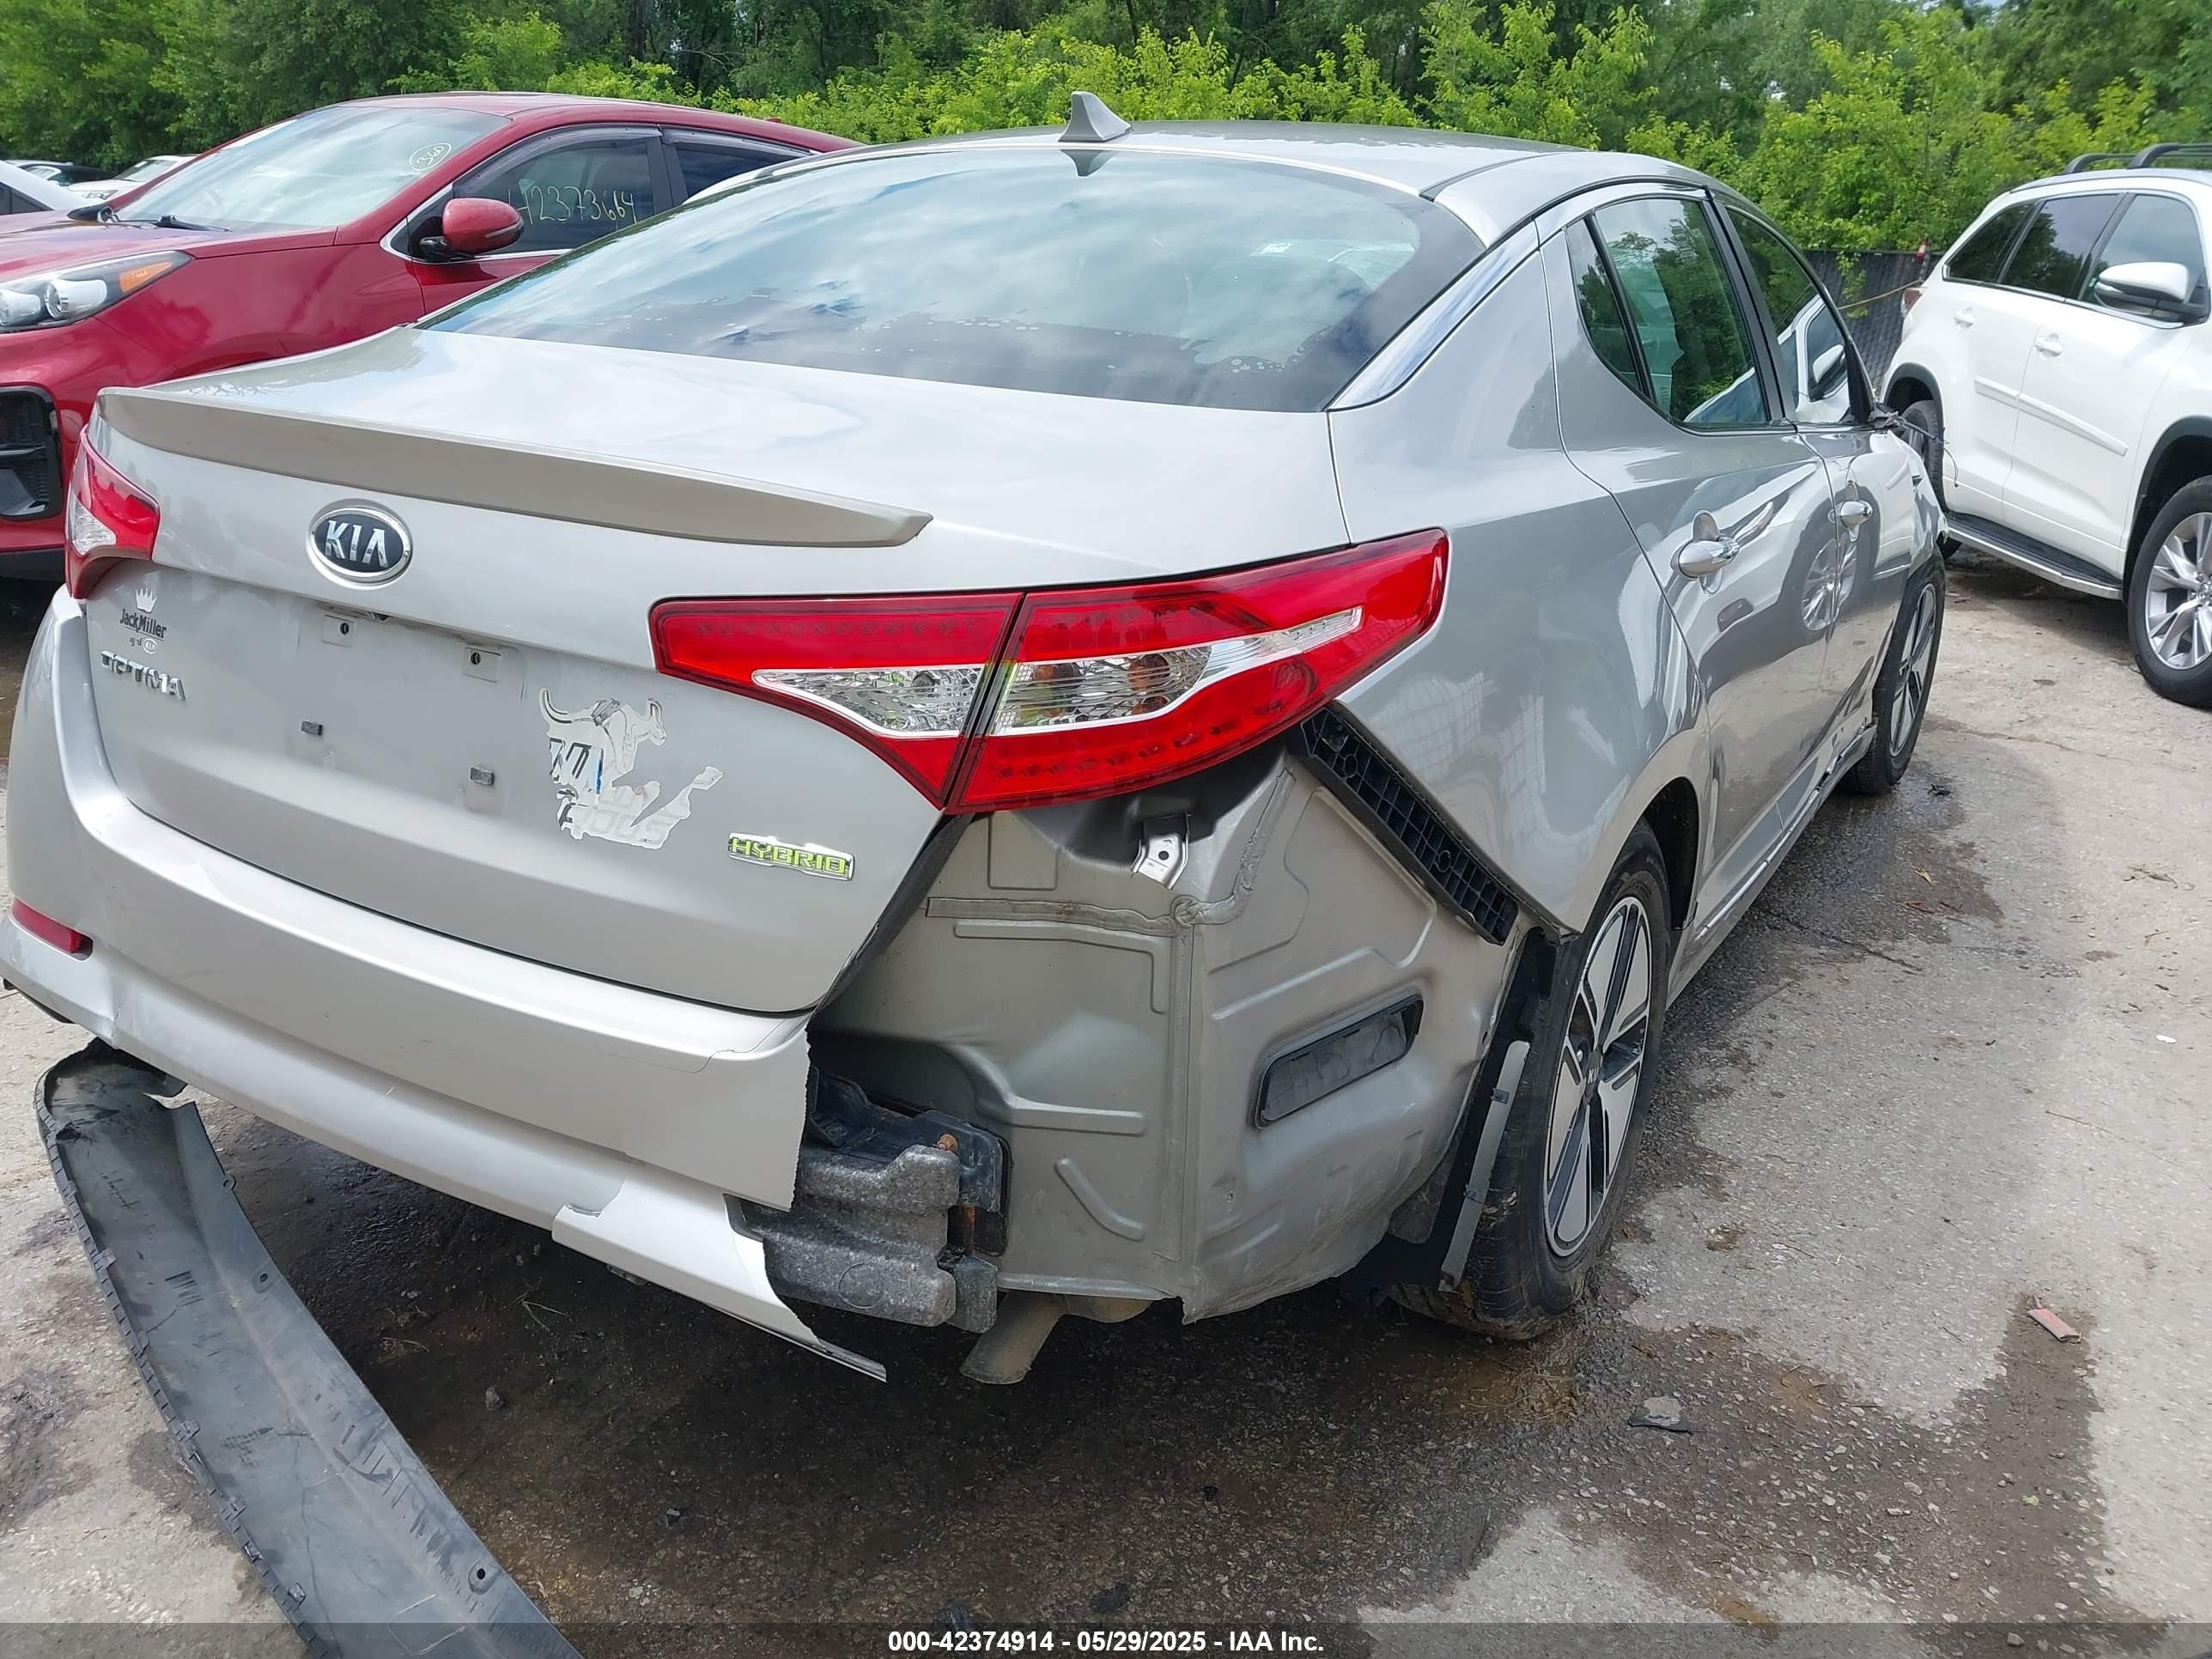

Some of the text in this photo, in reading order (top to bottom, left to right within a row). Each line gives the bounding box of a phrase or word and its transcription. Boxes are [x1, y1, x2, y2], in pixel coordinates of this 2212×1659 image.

[416, 145, 445, 166] 360
[325, 520, 388, 568] KIA
[731, 837, 847, 875] HYBRID
